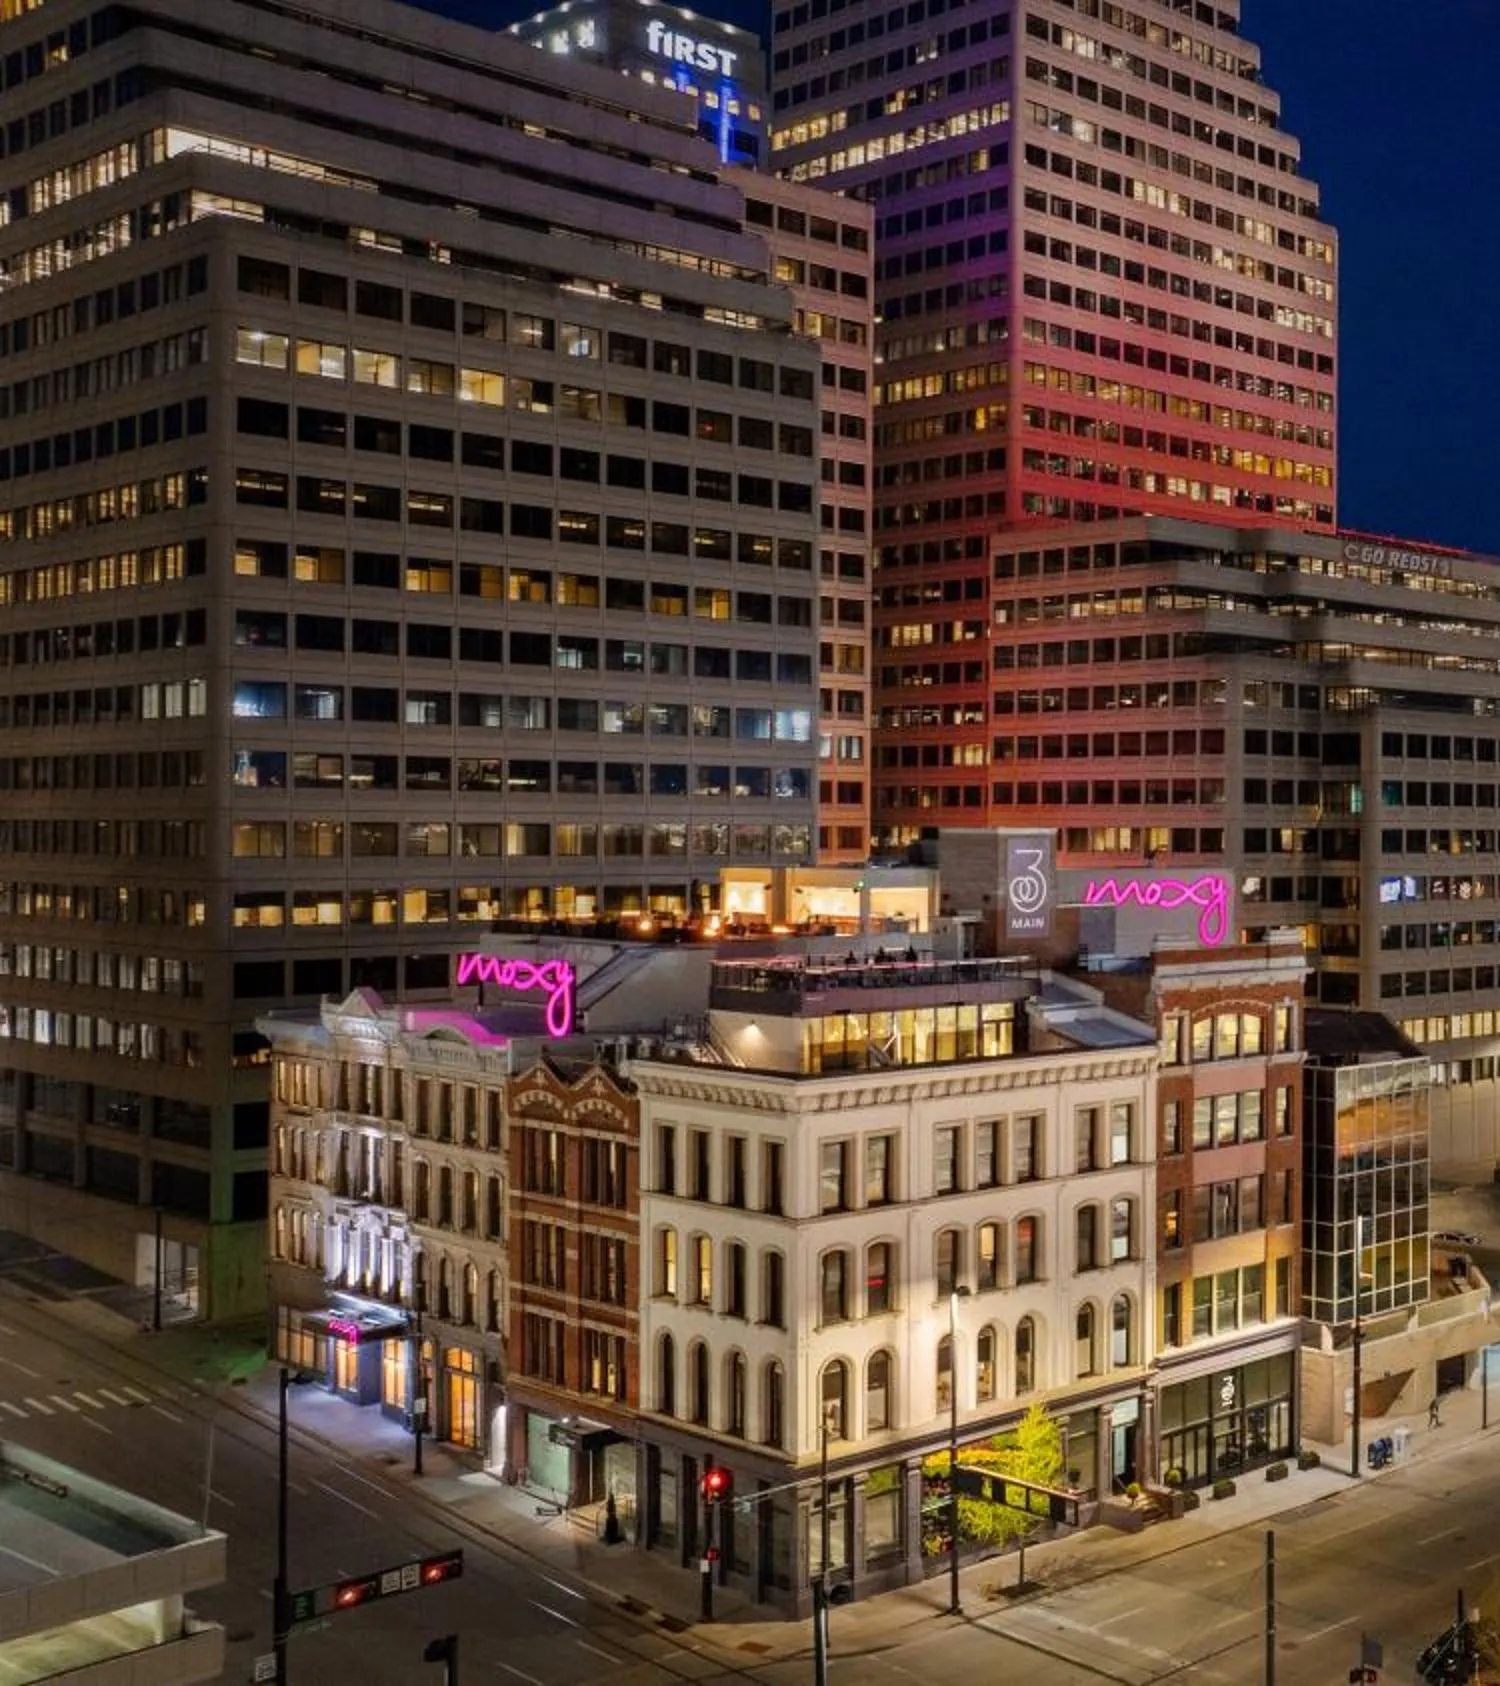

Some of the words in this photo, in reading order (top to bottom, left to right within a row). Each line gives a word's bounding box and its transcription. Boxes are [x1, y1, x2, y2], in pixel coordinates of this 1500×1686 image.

[1361, 546, 1385, 564] GO
[1011, 916, 1044, 929] MAIN
[1085, 875, 1225, 944] moxy
[457, 953, 574, 1037] moxy
